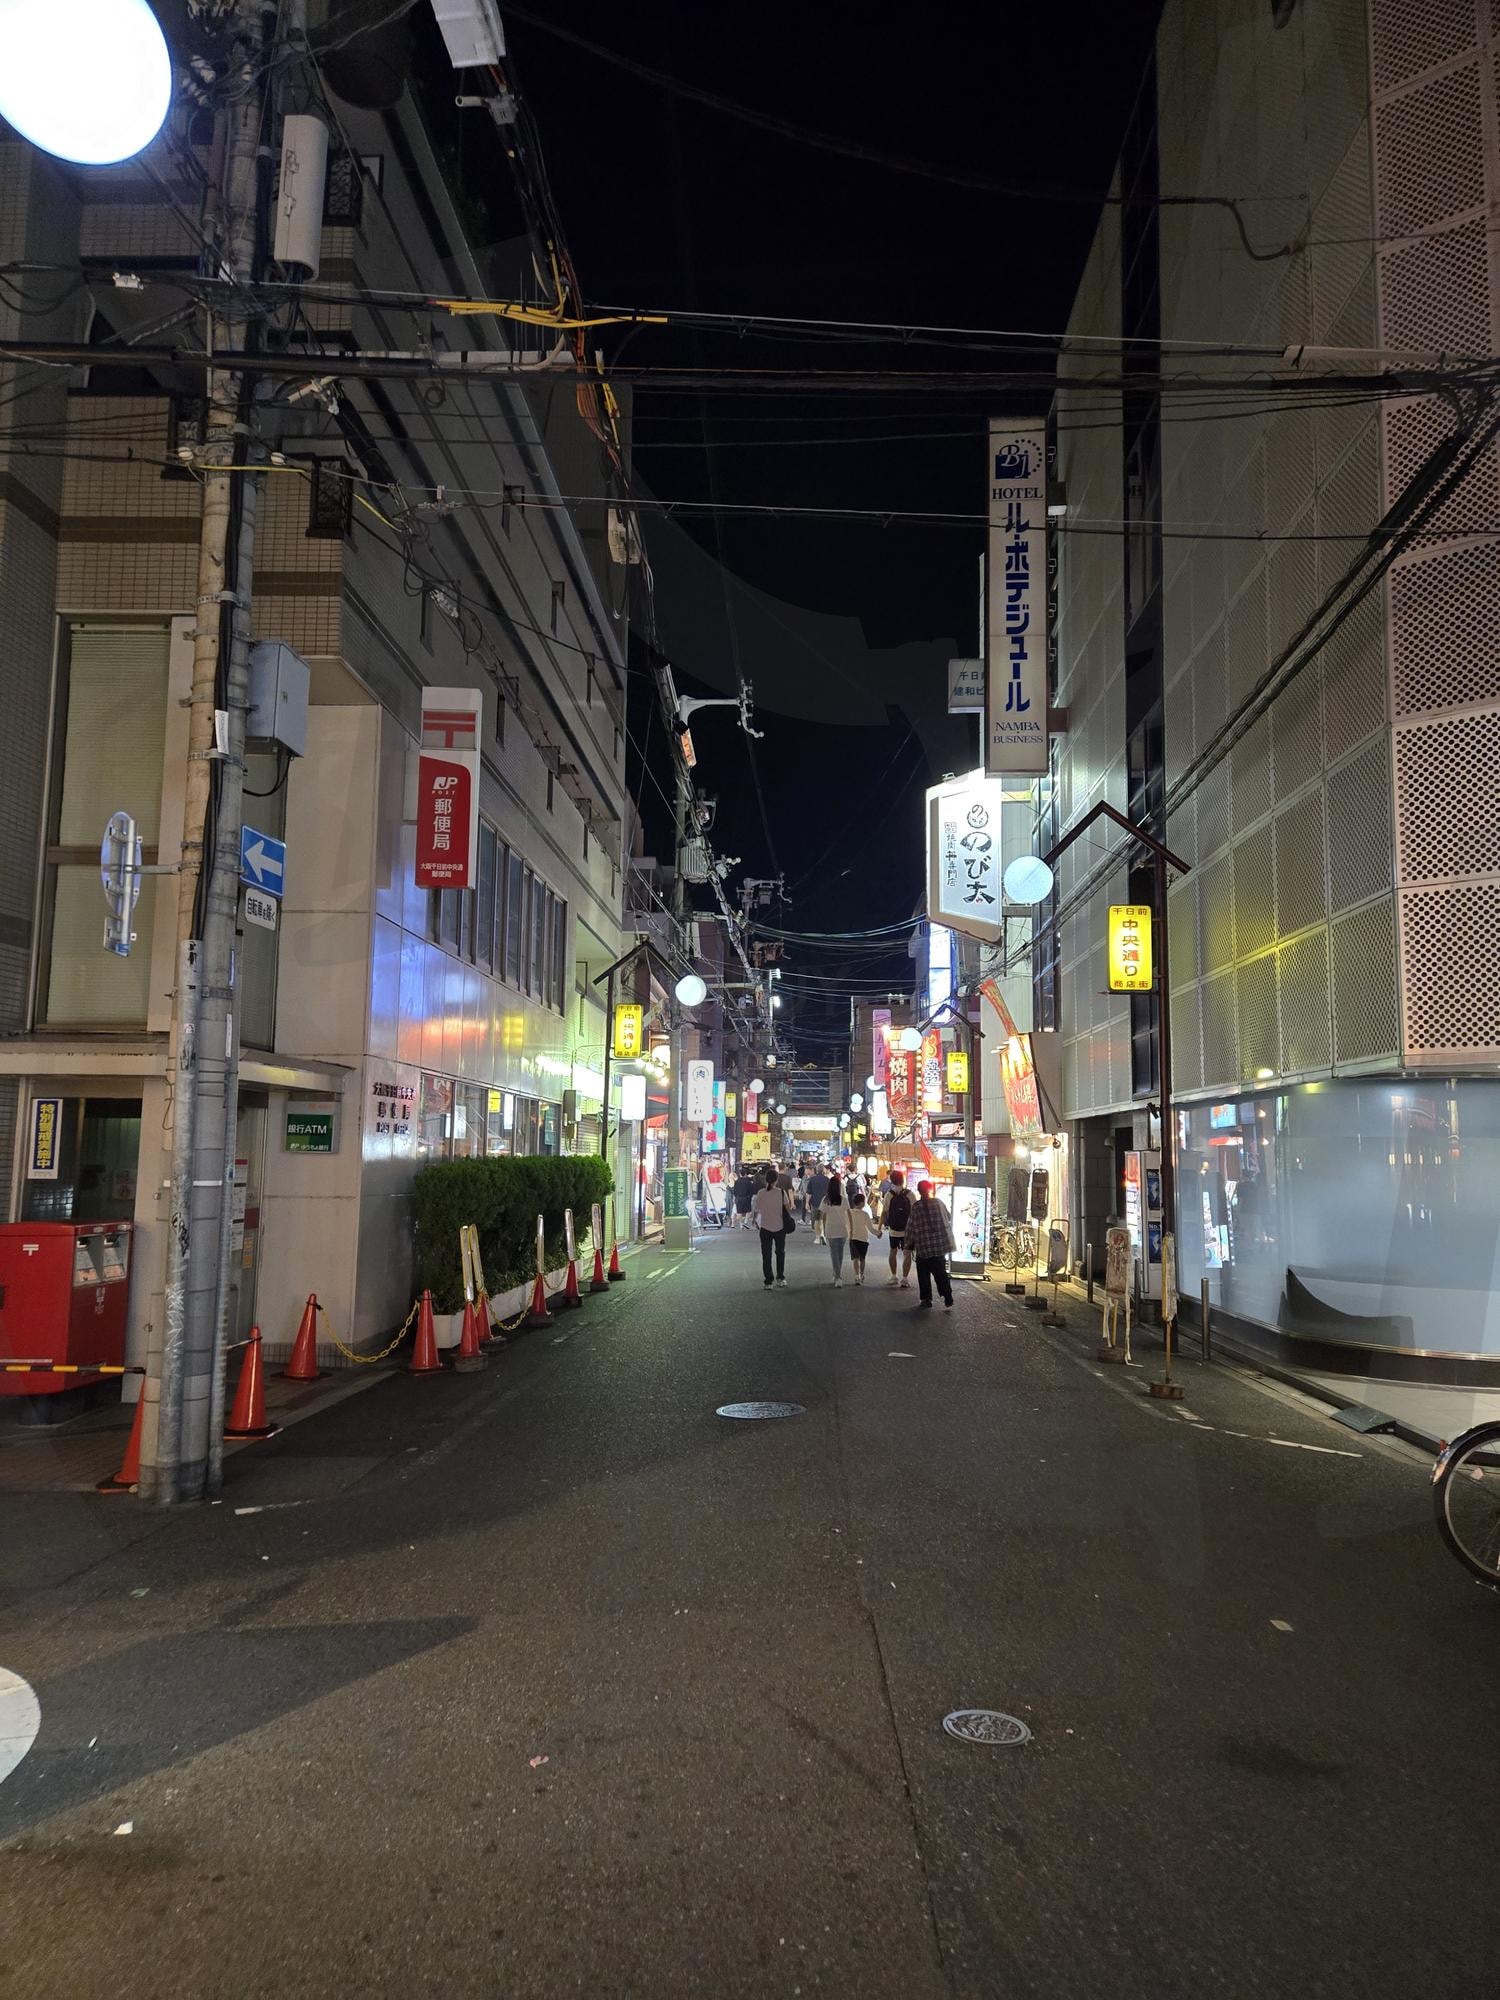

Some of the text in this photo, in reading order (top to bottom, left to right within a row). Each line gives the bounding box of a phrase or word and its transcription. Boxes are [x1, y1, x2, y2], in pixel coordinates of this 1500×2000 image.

[992, 488, 1043, 500] HOTEL
[959, 671, 984, 681] 千日
[995, 721, 1040, 731] NAMBA
[993, 734, 1043, 744] BUSINESS
[432, 798, 452, 850] 郵便局
[960, 831, 996, 905] のび太
[1112, 907, 1148, 916] 千日前
[1122, 919, 1140, 977] 中央通り
[1113, 980, 1149, 988] 商店街
[888, 1057, 908, 1096] 焼肉
[287, 1124, 327, 1135] 銀行ATM
